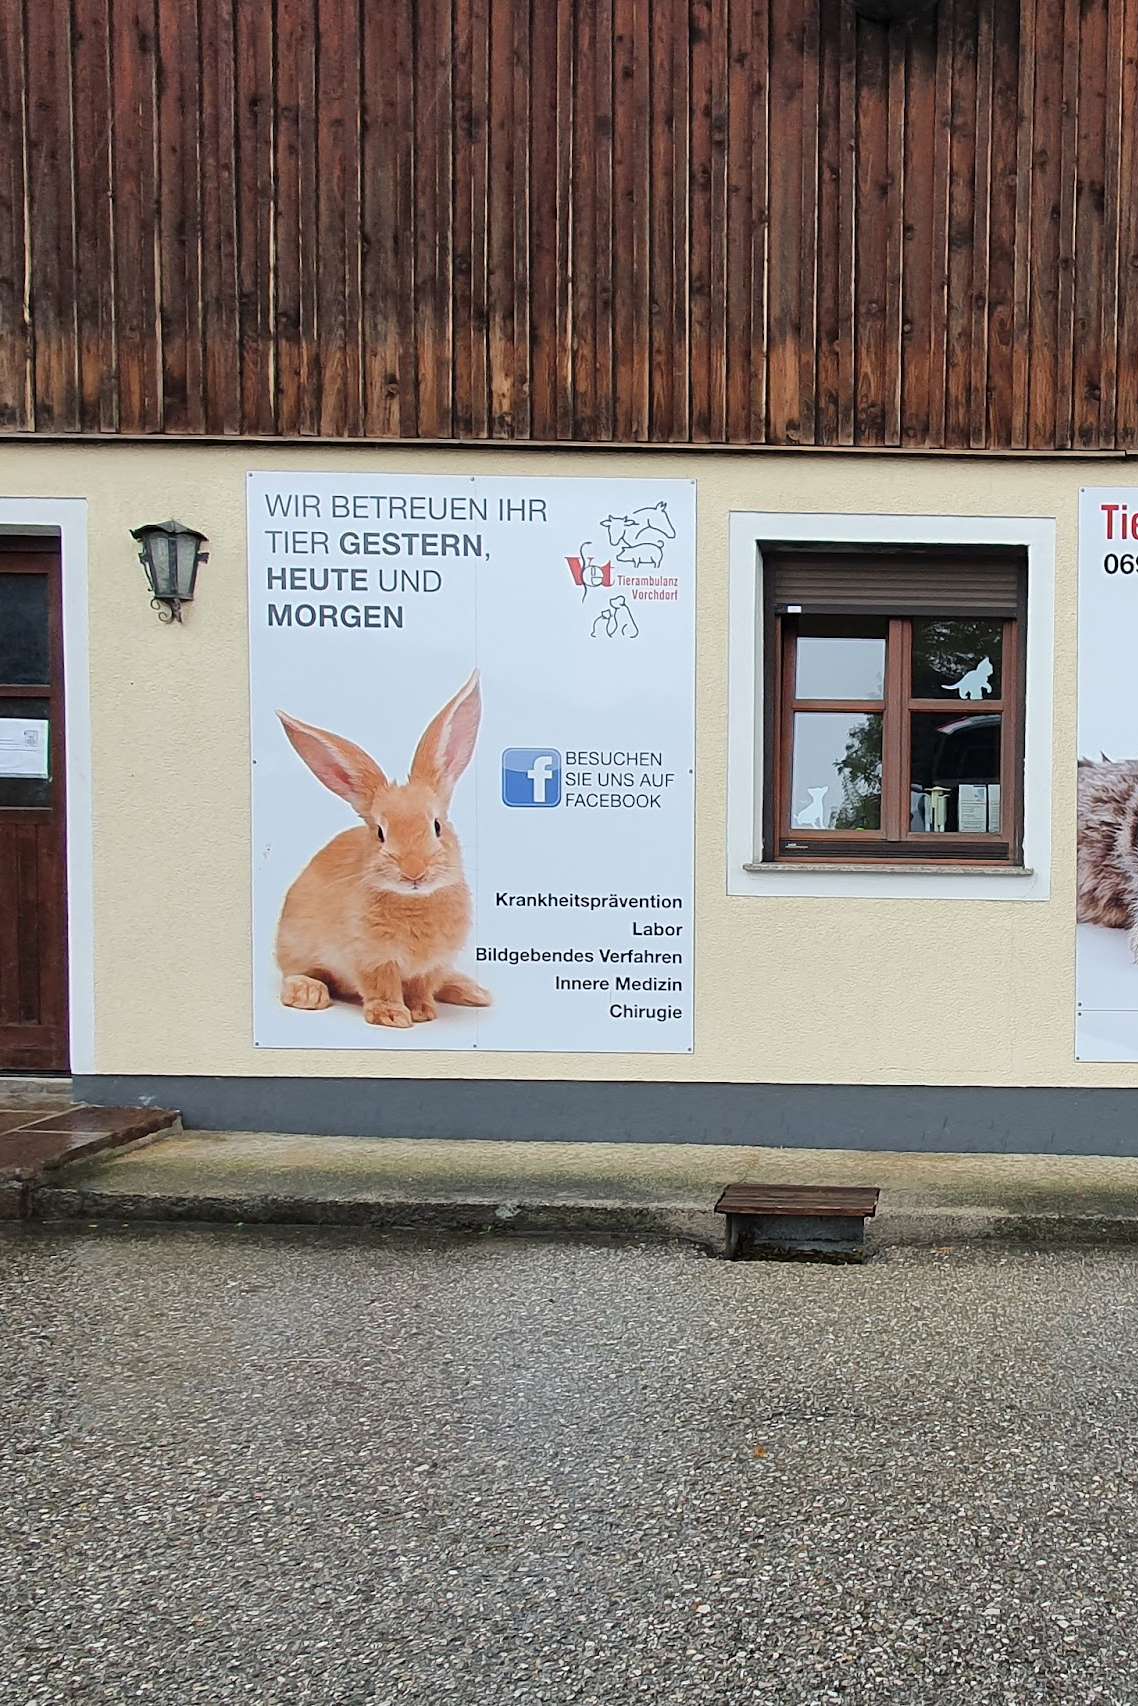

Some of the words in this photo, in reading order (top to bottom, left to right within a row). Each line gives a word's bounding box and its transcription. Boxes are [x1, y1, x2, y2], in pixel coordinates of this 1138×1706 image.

[265, 494, 320, 518] WIR
[332, 496, 487, 520] BETREUEN
[499, 499, 547, 522] IHR
[265, 531, 329, 554] TIER
[340, 532, 489, 561] GESTERN,
[268, 567, 368, 591] HEUTE
[379, 569, 441, 592] UND
[618, 574, 678, 586] Tierambulanz
[632, 590, 678, 601] Vorchdorf
[268, 604, 403, 628] MORGEN
[566, 752, 662, 766] BESUCHEN
[565, 772, 592, 786] SIE
[598, 773, 634, 787] UNS
[640, 773, 675, 788] AUF
[566, 793, 661, 808] FACEBOOK
[496, 892, 682, 911] Krankheitsprävention
[633, 922, 682, 936] Labor
[476, 948, 594, 966] Bildgebendes
[599, 949, 682, 964] Verfahren
[556, 976, 609, 990] Innere
[616, 977, 682, 991] Medizin
[610, 1004, 682, 1022] Chirugie
